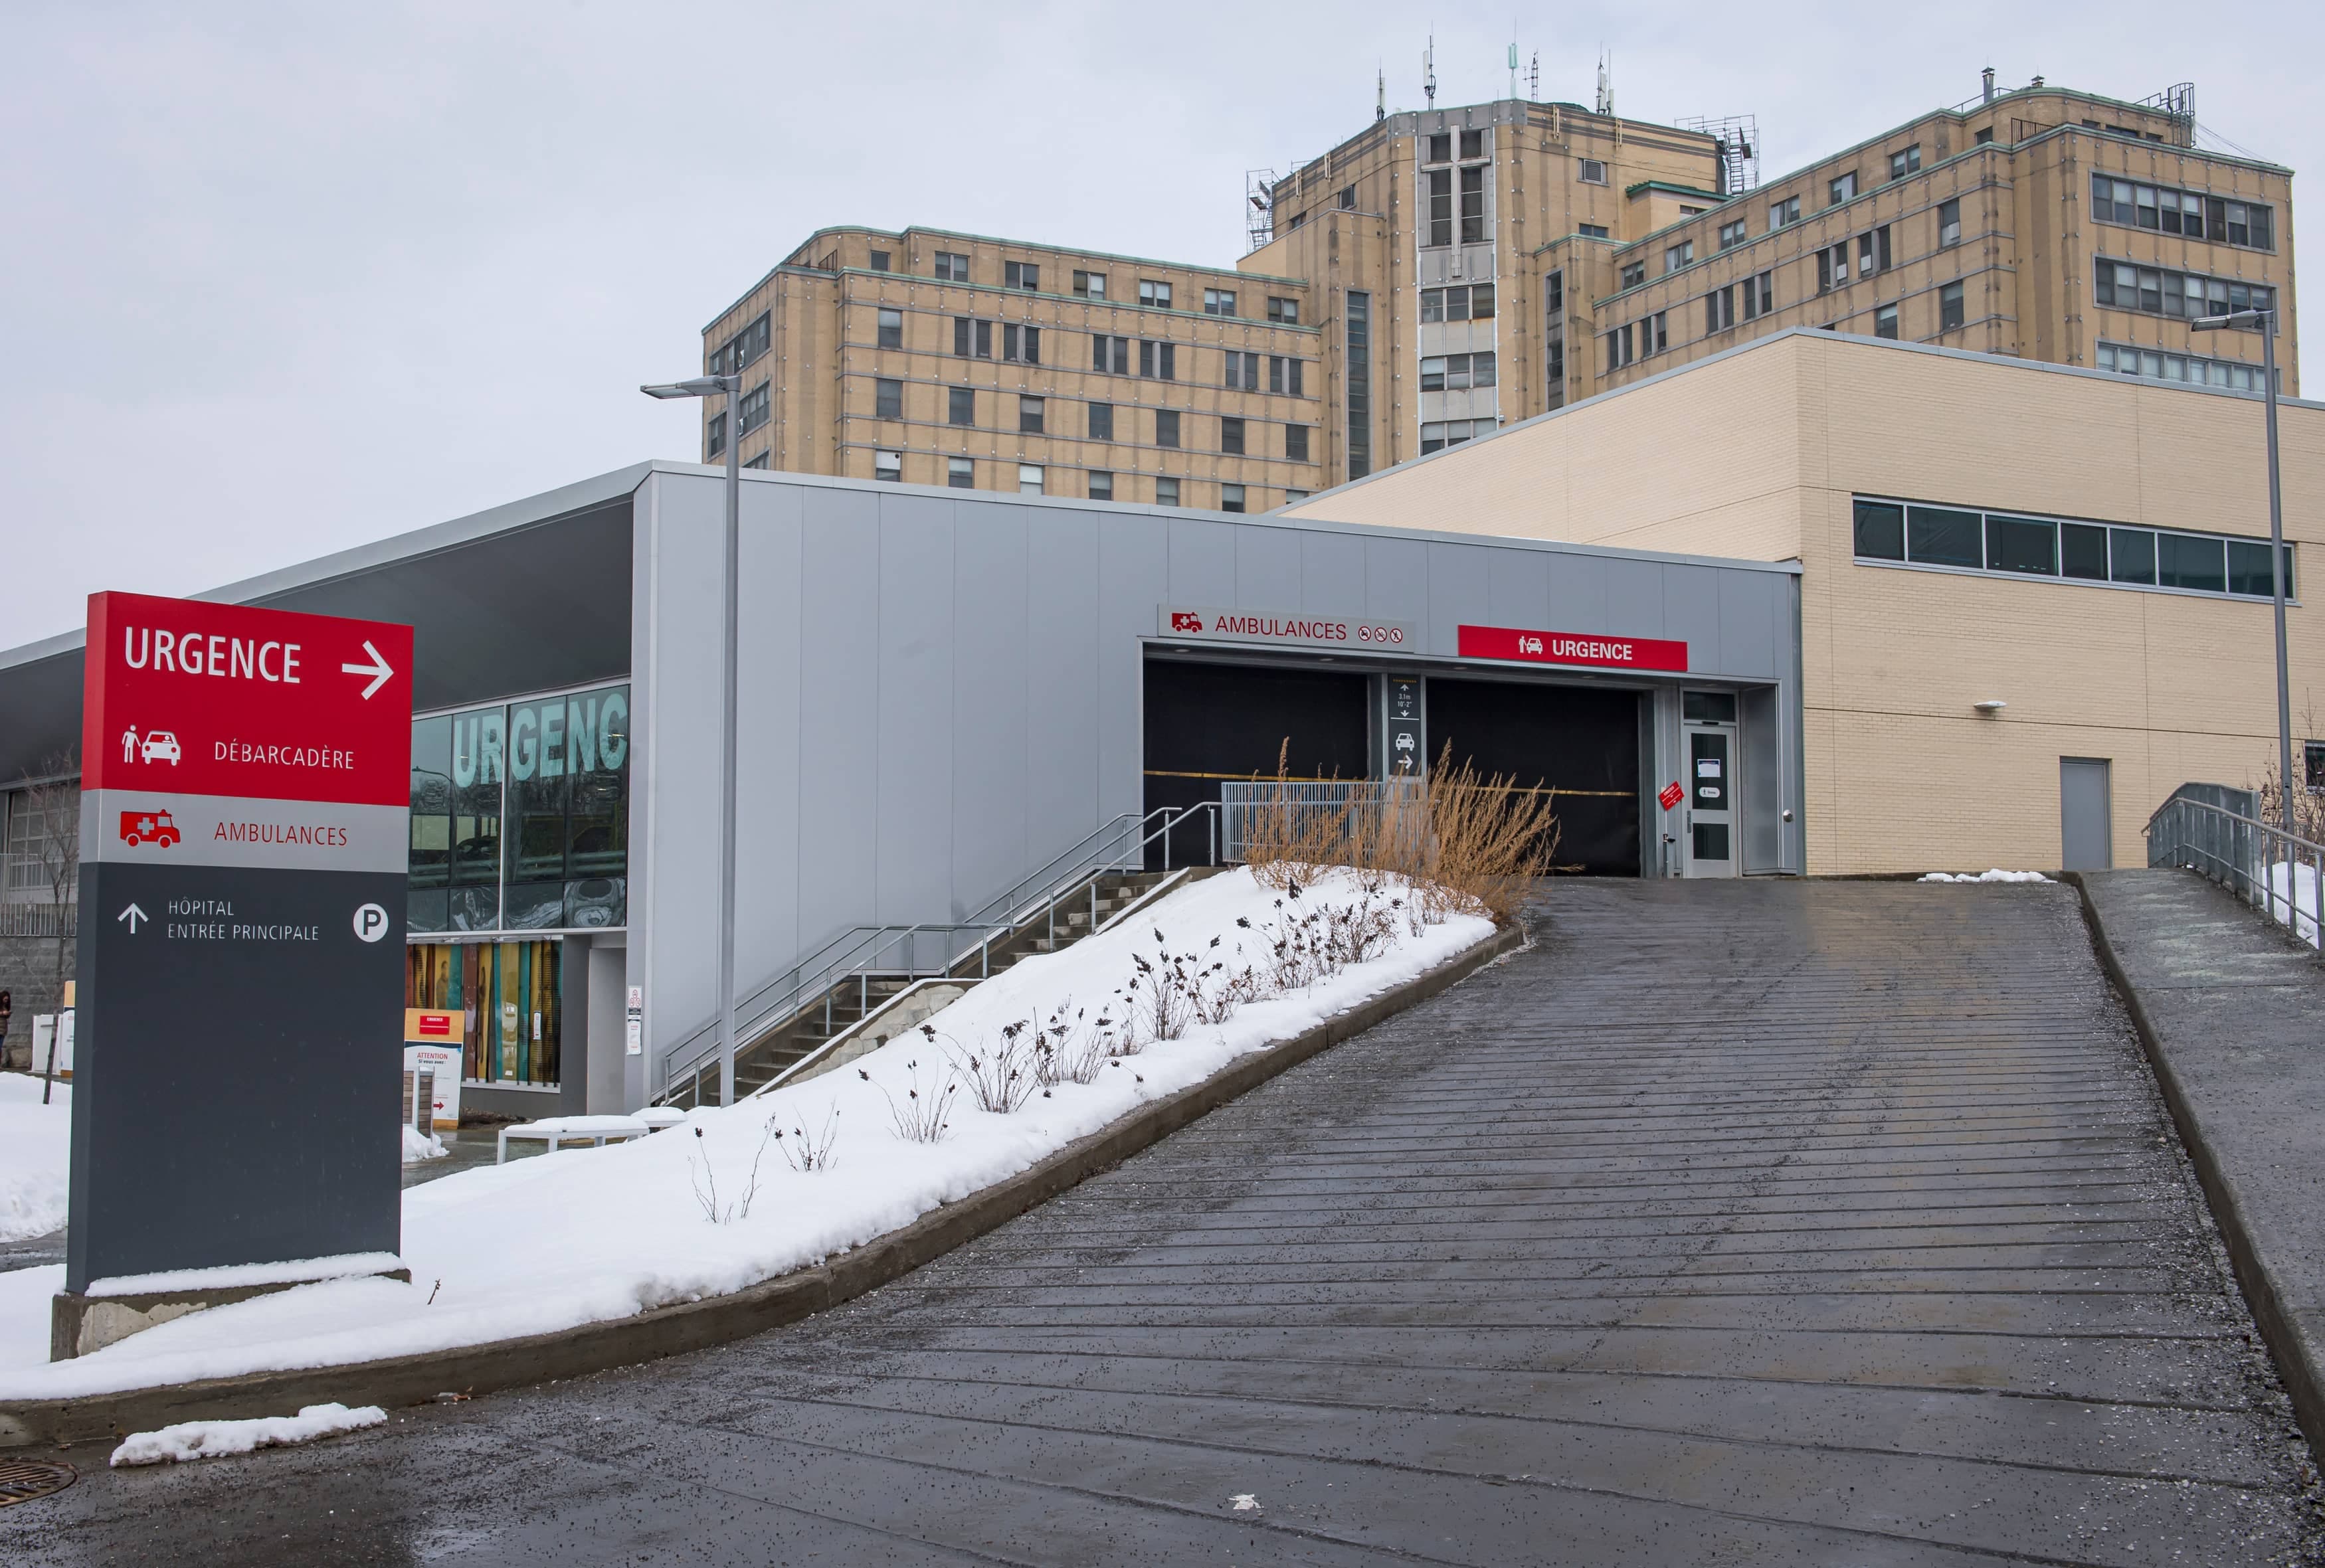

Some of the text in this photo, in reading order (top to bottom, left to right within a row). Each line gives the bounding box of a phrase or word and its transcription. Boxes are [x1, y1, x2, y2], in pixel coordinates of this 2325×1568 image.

[1215, 616, 1347, 640] AMBULANCES
[125, 626, 301, 683] URGENCE
[1552, 640, 1633, 661] URGENCE
[215, 738, 354, 770] DÉBARCADÈRE
[214, 822, 347, 847] AMBULANCES
[169, 896, 234, 916] HÔPITAL
[168, 920, 319, 941] ENTRÉE PRINCIPALE
[363, 909, 381, 936] P
